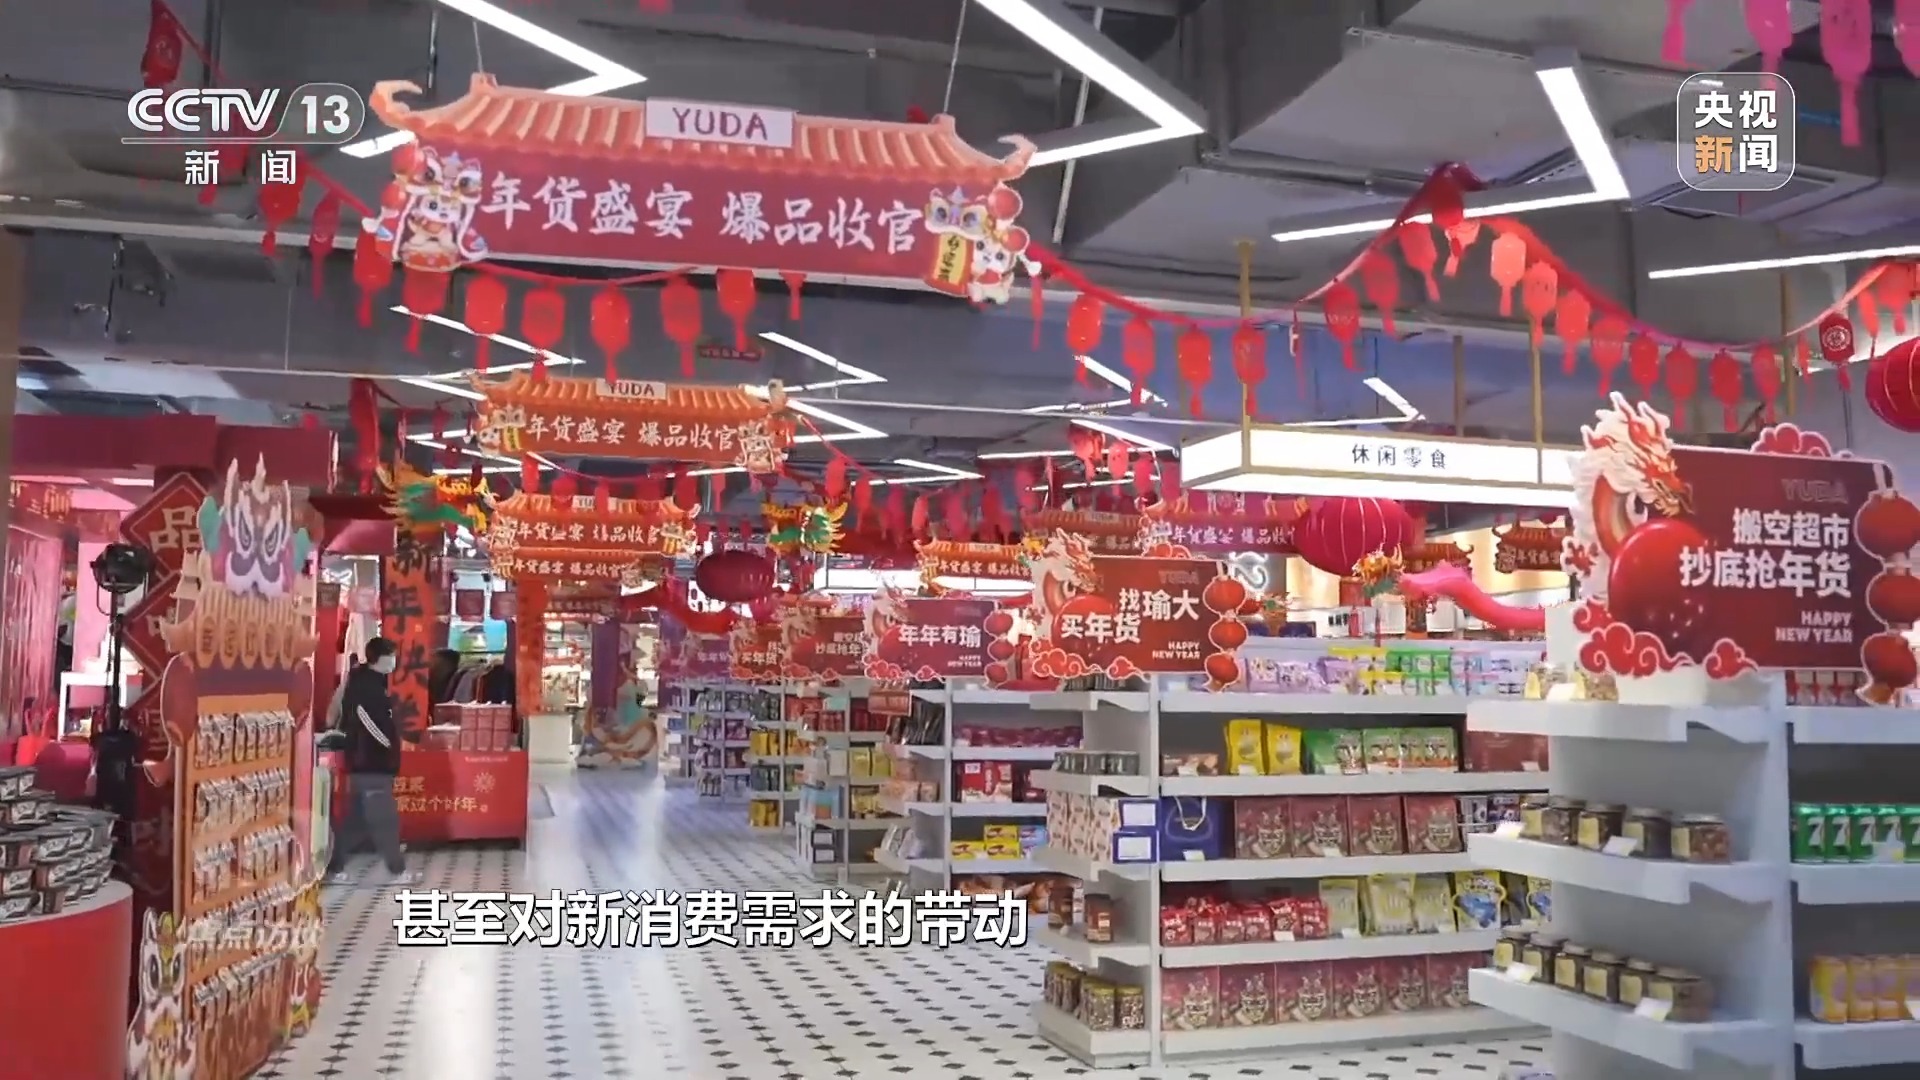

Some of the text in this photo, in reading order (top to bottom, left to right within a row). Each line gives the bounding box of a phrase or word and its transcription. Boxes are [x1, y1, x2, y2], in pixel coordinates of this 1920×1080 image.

[672, 106, 768, 141] YUDA
[481, 171, 924, 253] 年货盛宴 爆品收官
[526, 413, 626, 444] 年货盛宴
[639, 421, 738, 451] 爆品收官
[1352, 443, 1447, 469] 休闲零食
[1732, 507, 1850, 549] 搬空超市
[1680, 546, 1851, 599] 抄底抢年货
[1119, 588, 1200, 621] 找瑜大
[1801, 610, 1851, 626] HAPPY
[898, 624, 982, 648] 年年有瑜
[1060, 612, 1141, 644] 买年货
[1776, 627, 1852, 643] NEW YEAR
[1152, 650, 1173, 659] NEW
[1168, 641, 1200, 650] HAPPY
